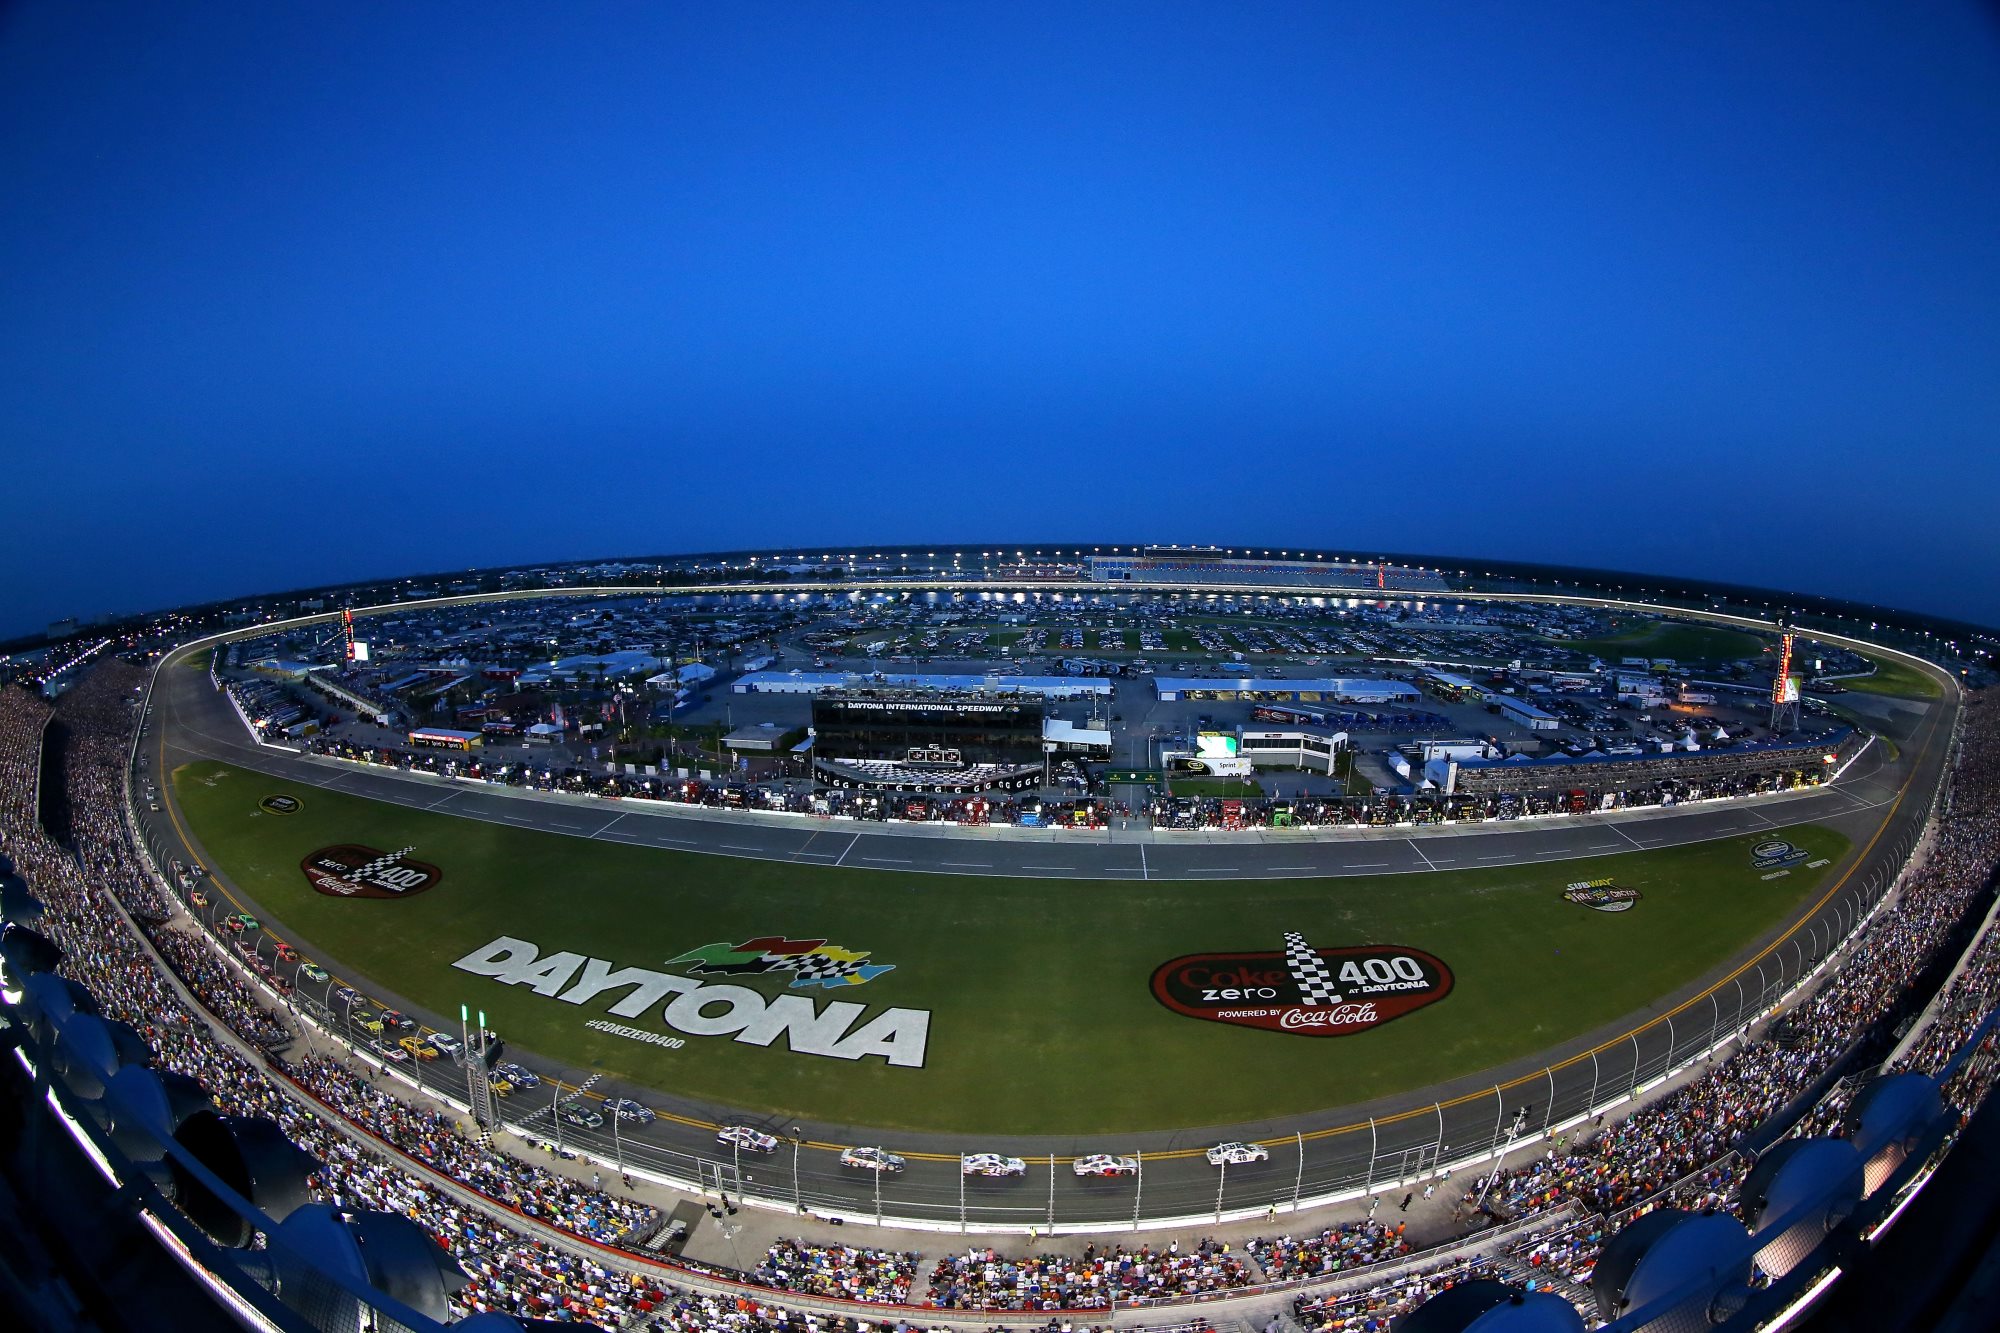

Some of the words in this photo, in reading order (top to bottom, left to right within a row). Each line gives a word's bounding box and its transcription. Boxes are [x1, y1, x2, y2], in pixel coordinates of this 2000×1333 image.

[848, 702, 884, 710] DAYTONA
[885, 703, 954, 711] INTERNATIONAL
[956, 704, 1004, 712] SPEEDWAY
[1025, 778, 1031, 786] G
[1034, 776, 1040, 784] G
[915, 785, 922, 793] G
[318, 858, 348, 871] zero
[377, 866, 428, 887] 400
[1566, 877, 1614, 891] SUBWAY
[1179, 966, 1287, 988] Coke
[1338, 956, 1425, 986] 400
[1201, 986, 1277, 1002] zero
[1362, 979, 1430, 994] DAYTONA
[450, 935, 931, 1068] DAYTONA
[1218, 1009, 1268, 1018] POWERED
[1270, 1008, 1282, 1017] BY
[584, 1018, 686, 1050] #COKEZERO400
[1237, 1154, 1248, 1162] 48
